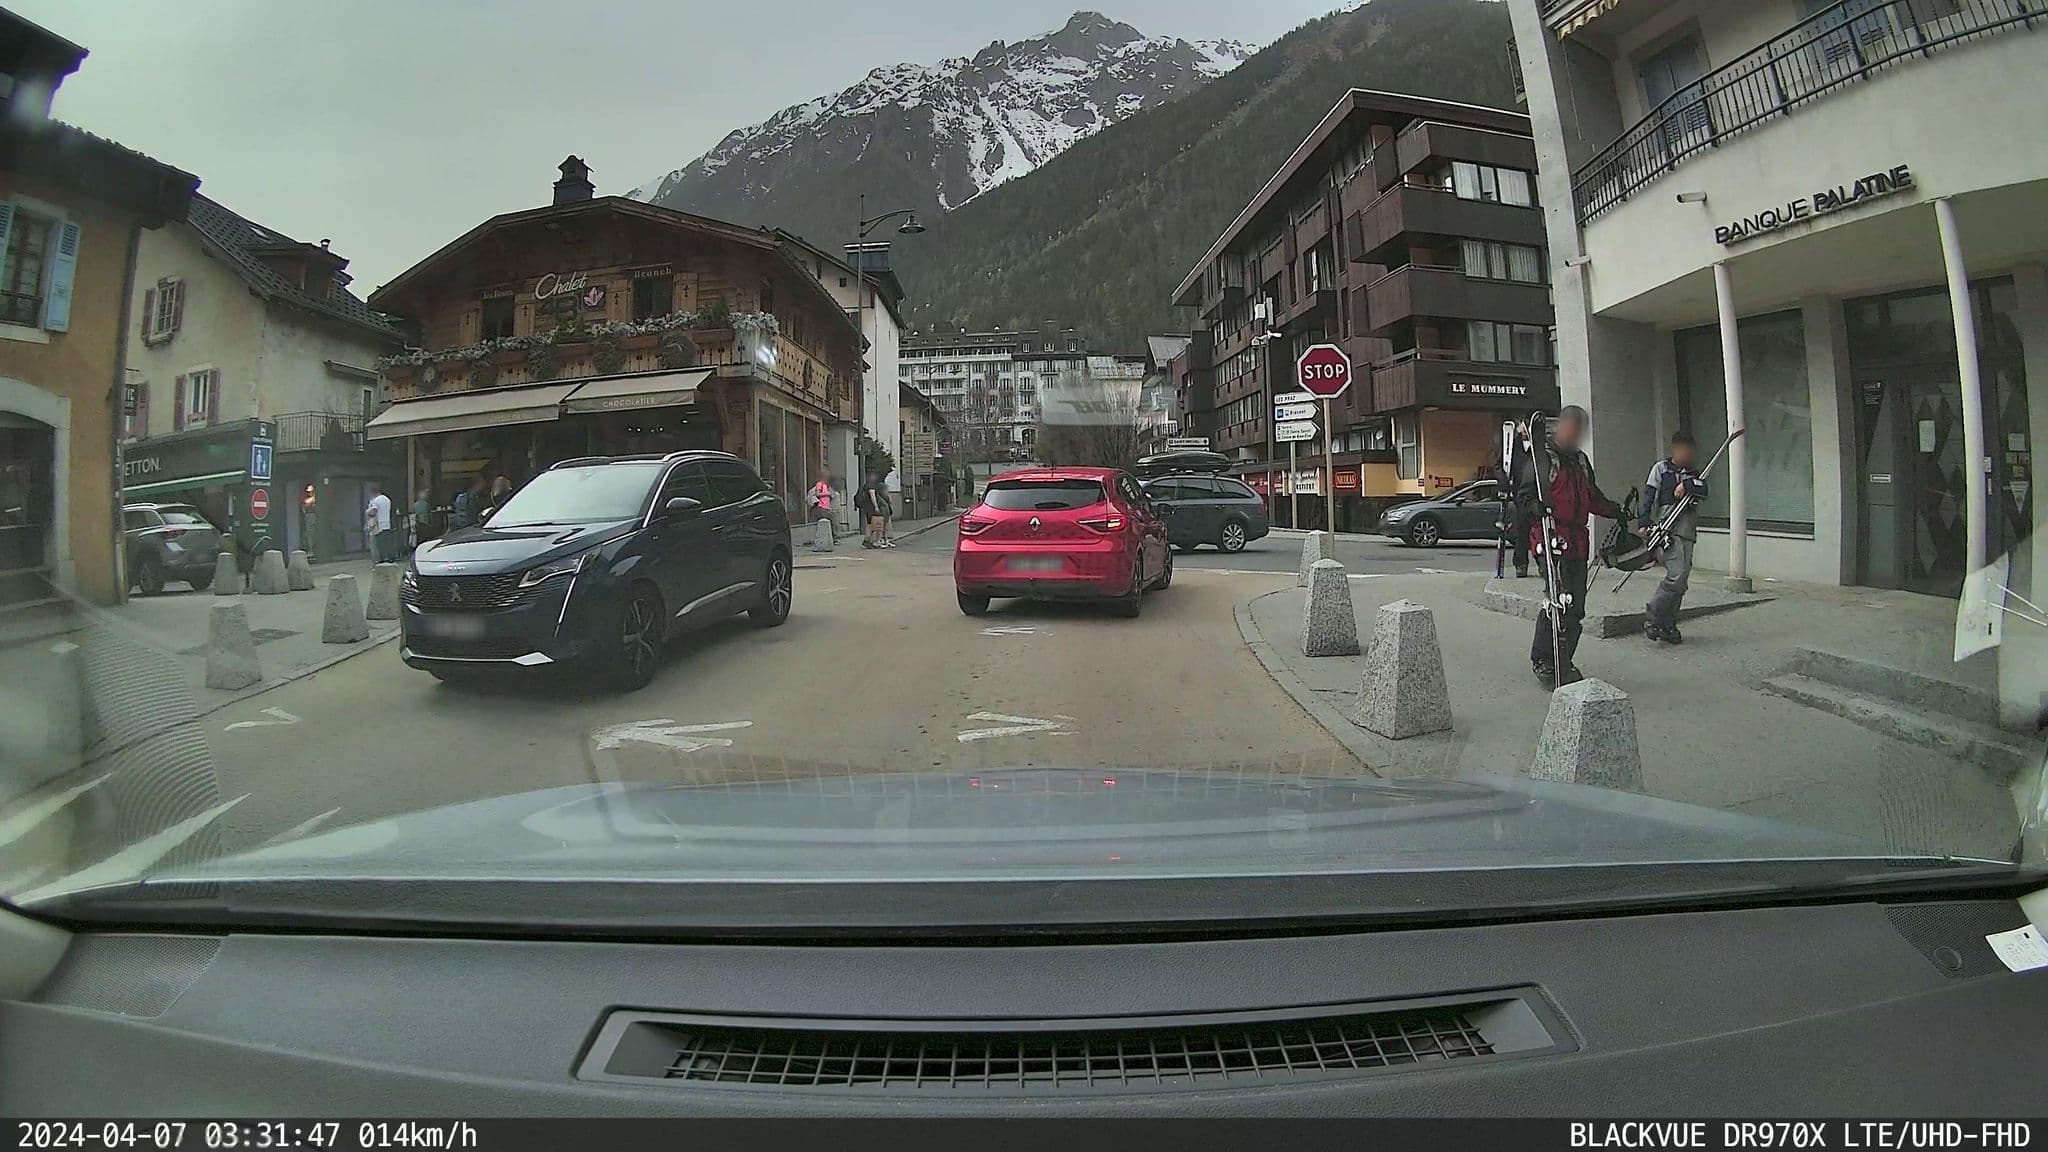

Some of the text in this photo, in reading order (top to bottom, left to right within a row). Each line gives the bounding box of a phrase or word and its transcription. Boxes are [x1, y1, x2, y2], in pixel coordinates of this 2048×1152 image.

[1714, 164, 1912, 244] BANQUE PALATINE
[535, 272, 588, 299] Chalet
[1304, 364, 1346, 379] STOP
[1452, 383, 1527, 395] LE MUMMERY
[124, 457, 161, 476] ETTON.
[1335, 474, 1356, 485] NICOLAS
